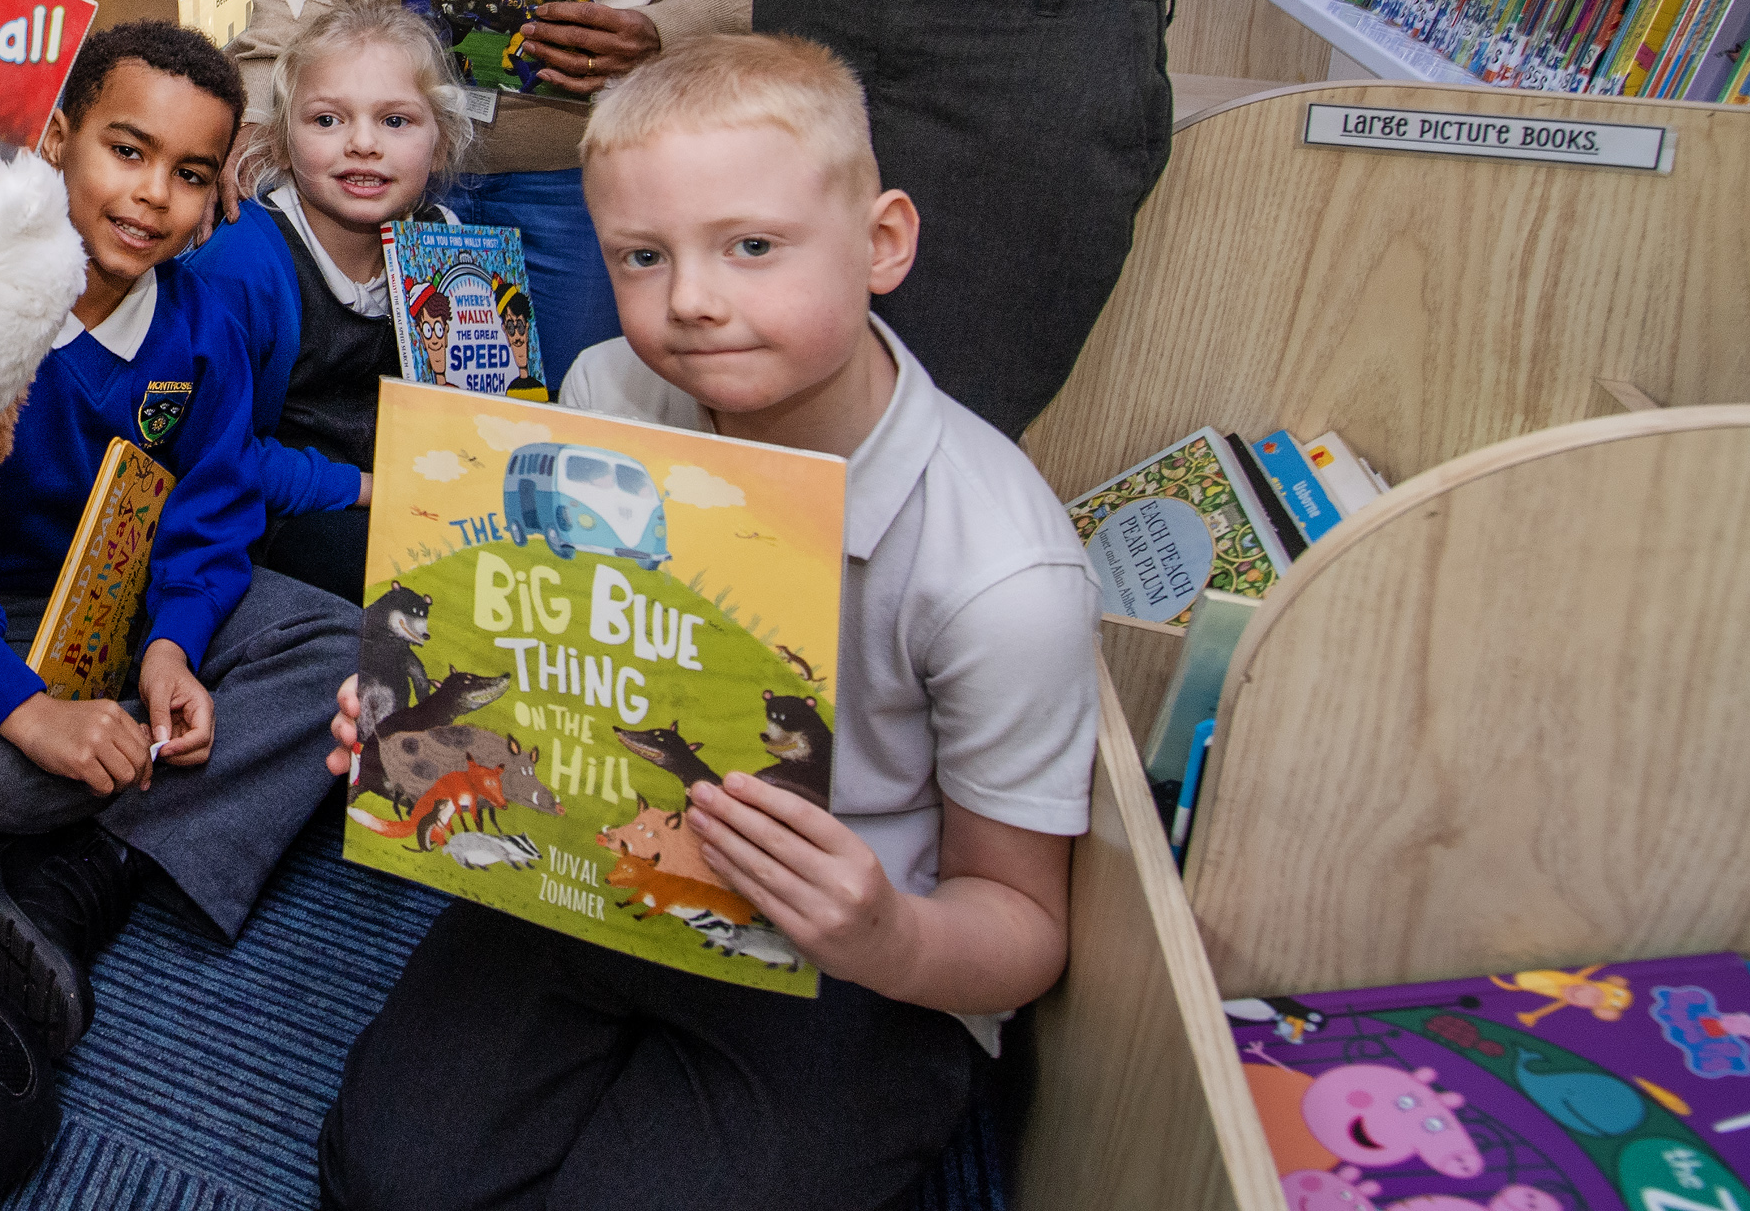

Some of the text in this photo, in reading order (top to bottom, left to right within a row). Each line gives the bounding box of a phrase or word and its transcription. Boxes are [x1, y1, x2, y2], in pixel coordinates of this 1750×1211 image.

[1342, 114, 1409, 137] Large
[1520, 126, 1600, 152] BOOKS.
[455, 295, 491, 308] WHERE'S
[457, 310, 494, 325] WALLY?
[456, 330, 499, 340] THE GREAT
[450, 344, 510, 372] SPEED
[147, 380, 193, 391] MONTROSE
[466, 373, 505, 394] SEARCH
[1291, 480, 1322, 520] Usborne
[449, 513, 504, 545] THE
[1119, 515, 1168, 606] PEAR PLUM
[1139, 500, 1195, 599] EACH PEACH
[50, 481, 126, 662] ROALD DAHL
[74, 505, 150, 685] BONANZA
[590, 563, 705, 671] BLUE
[514, 700, 595, 745] ON THE
[549, 844, 601, 888] YUVAL
[539, 873, 606, 921] ZOMMER
